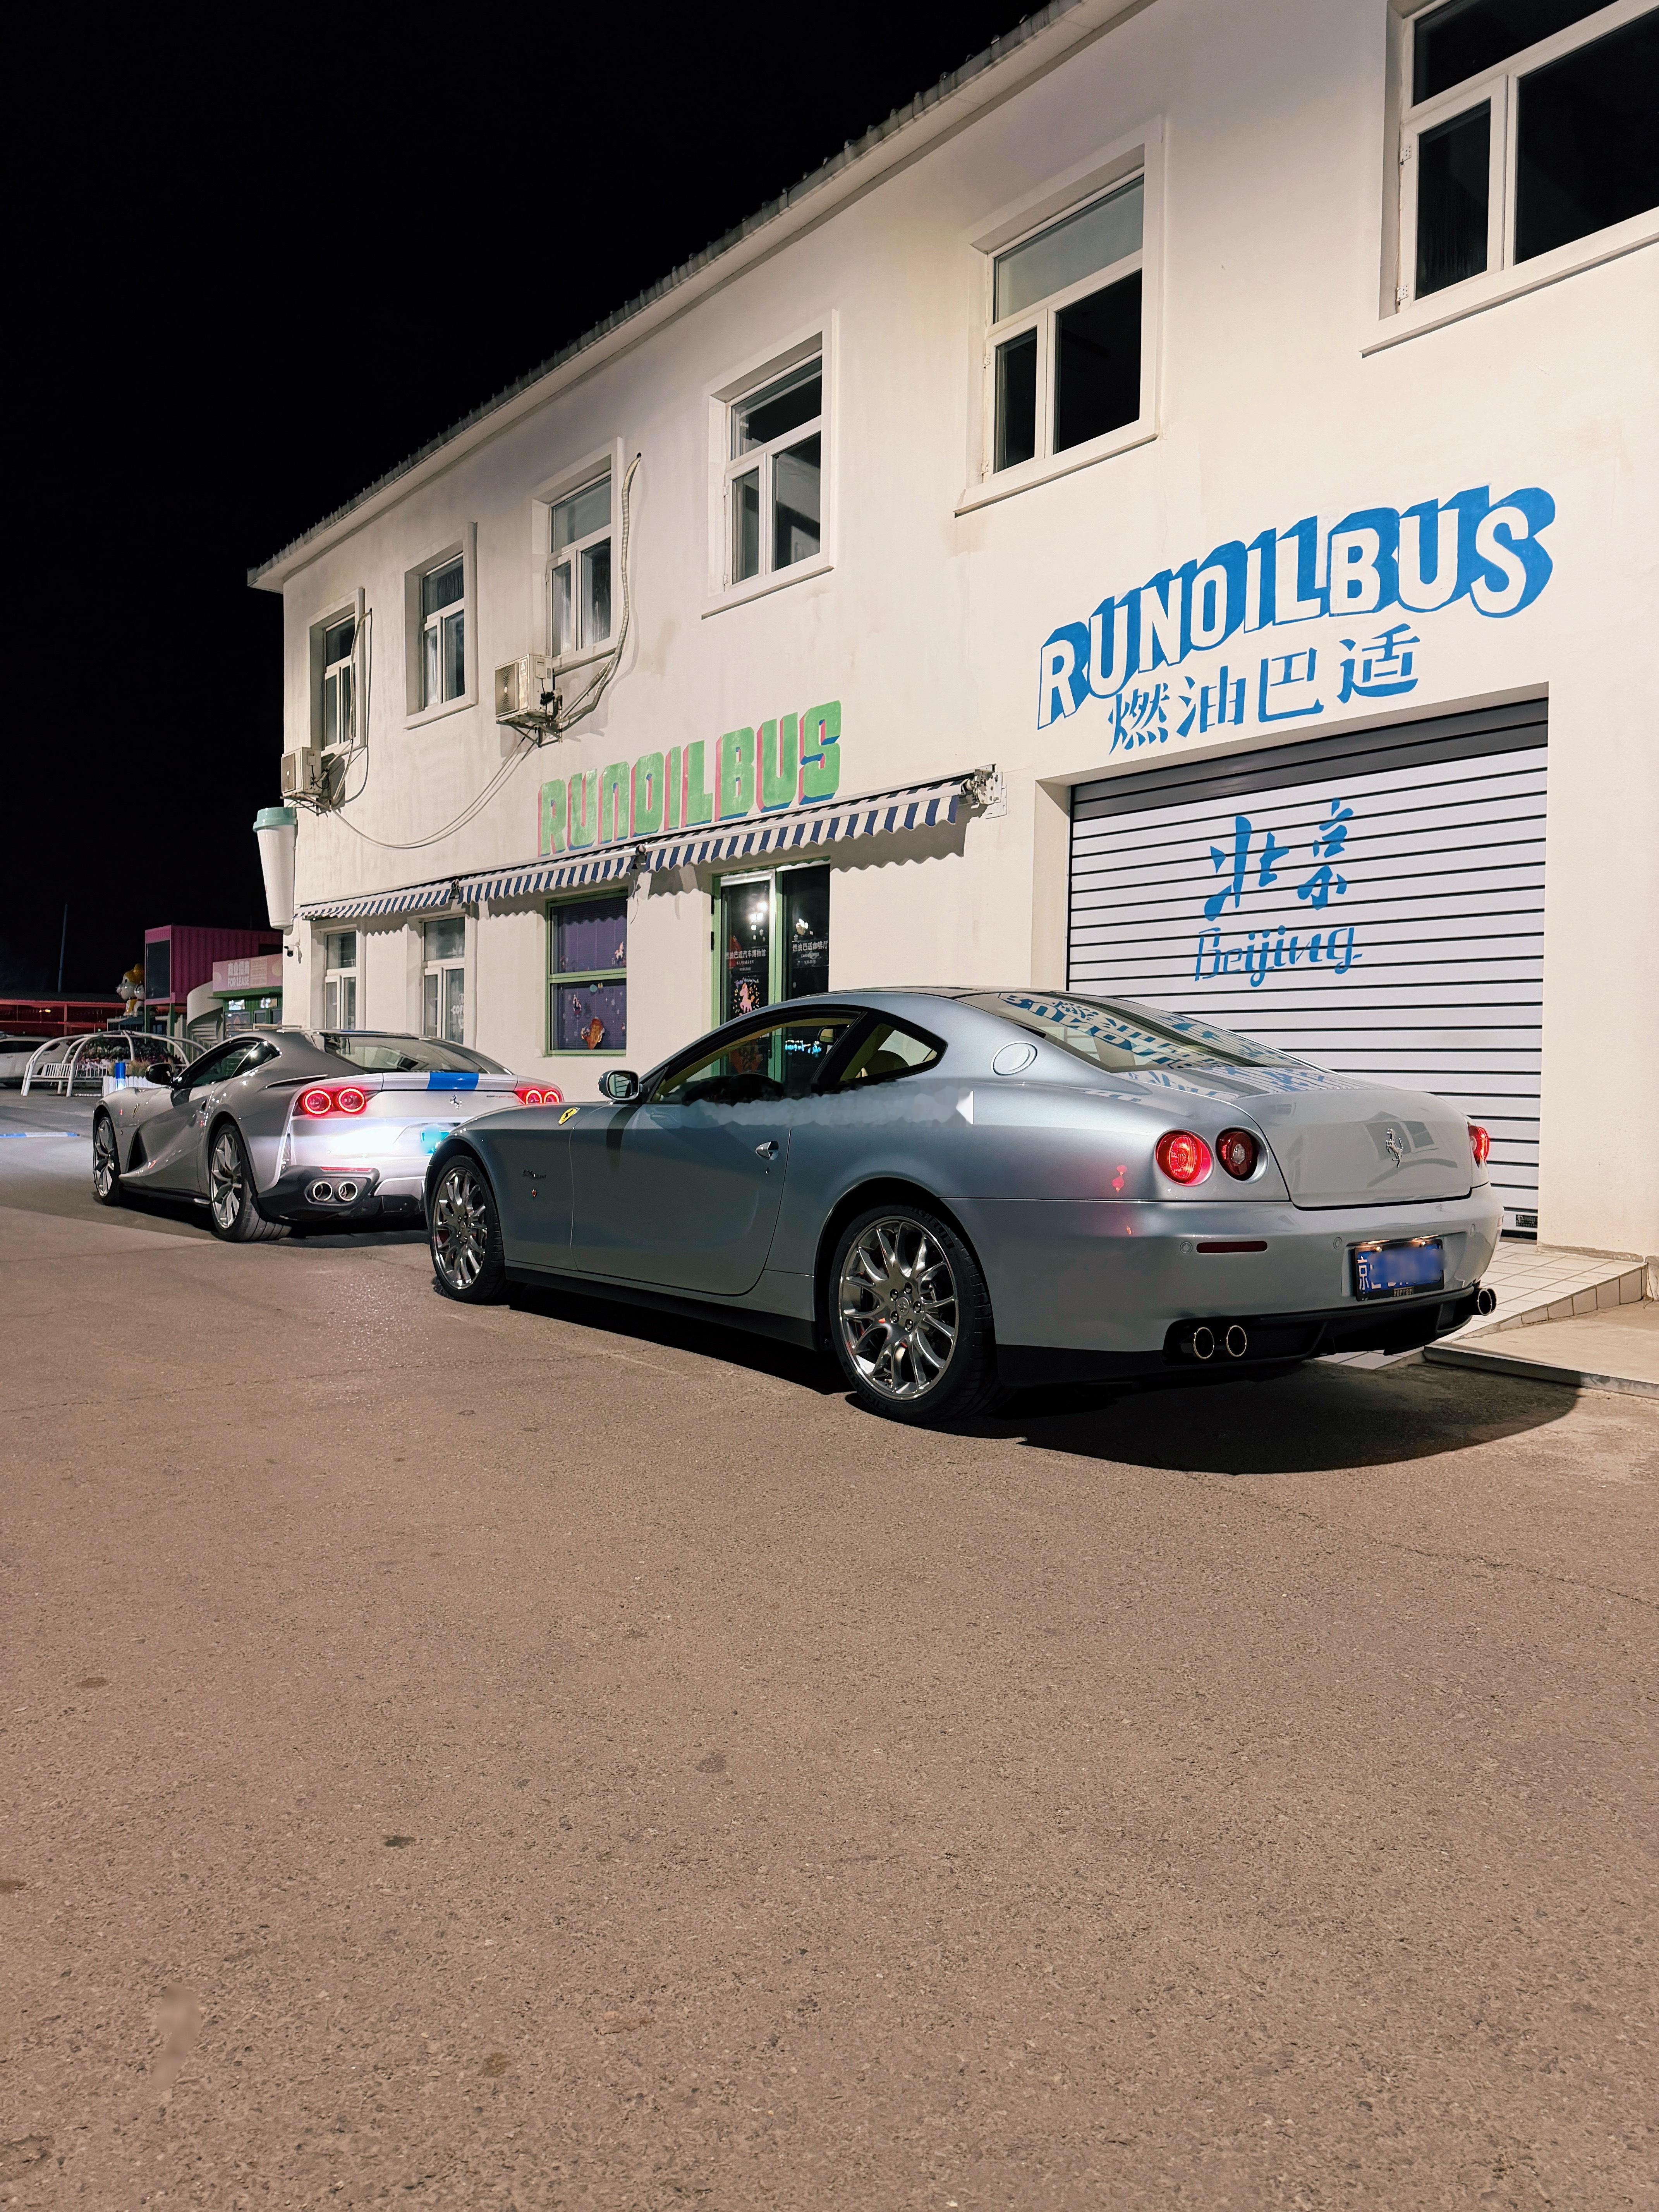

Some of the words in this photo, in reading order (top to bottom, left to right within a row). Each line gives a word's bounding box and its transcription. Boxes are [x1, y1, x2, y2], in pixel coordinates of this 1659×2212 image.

[1038, 484, 1556, 730] RUNOILBUS
[1109, 623, 1420, 755] 燃油巴适
[538, 700, 841, 857] RUNOILBUS
[1204, 798, 1353, 921] 北京
[228, 977, 236, 987] FOR
[237, 976, 249, 986] LEASE
[1195, 925, 1362, 987] Beijing
